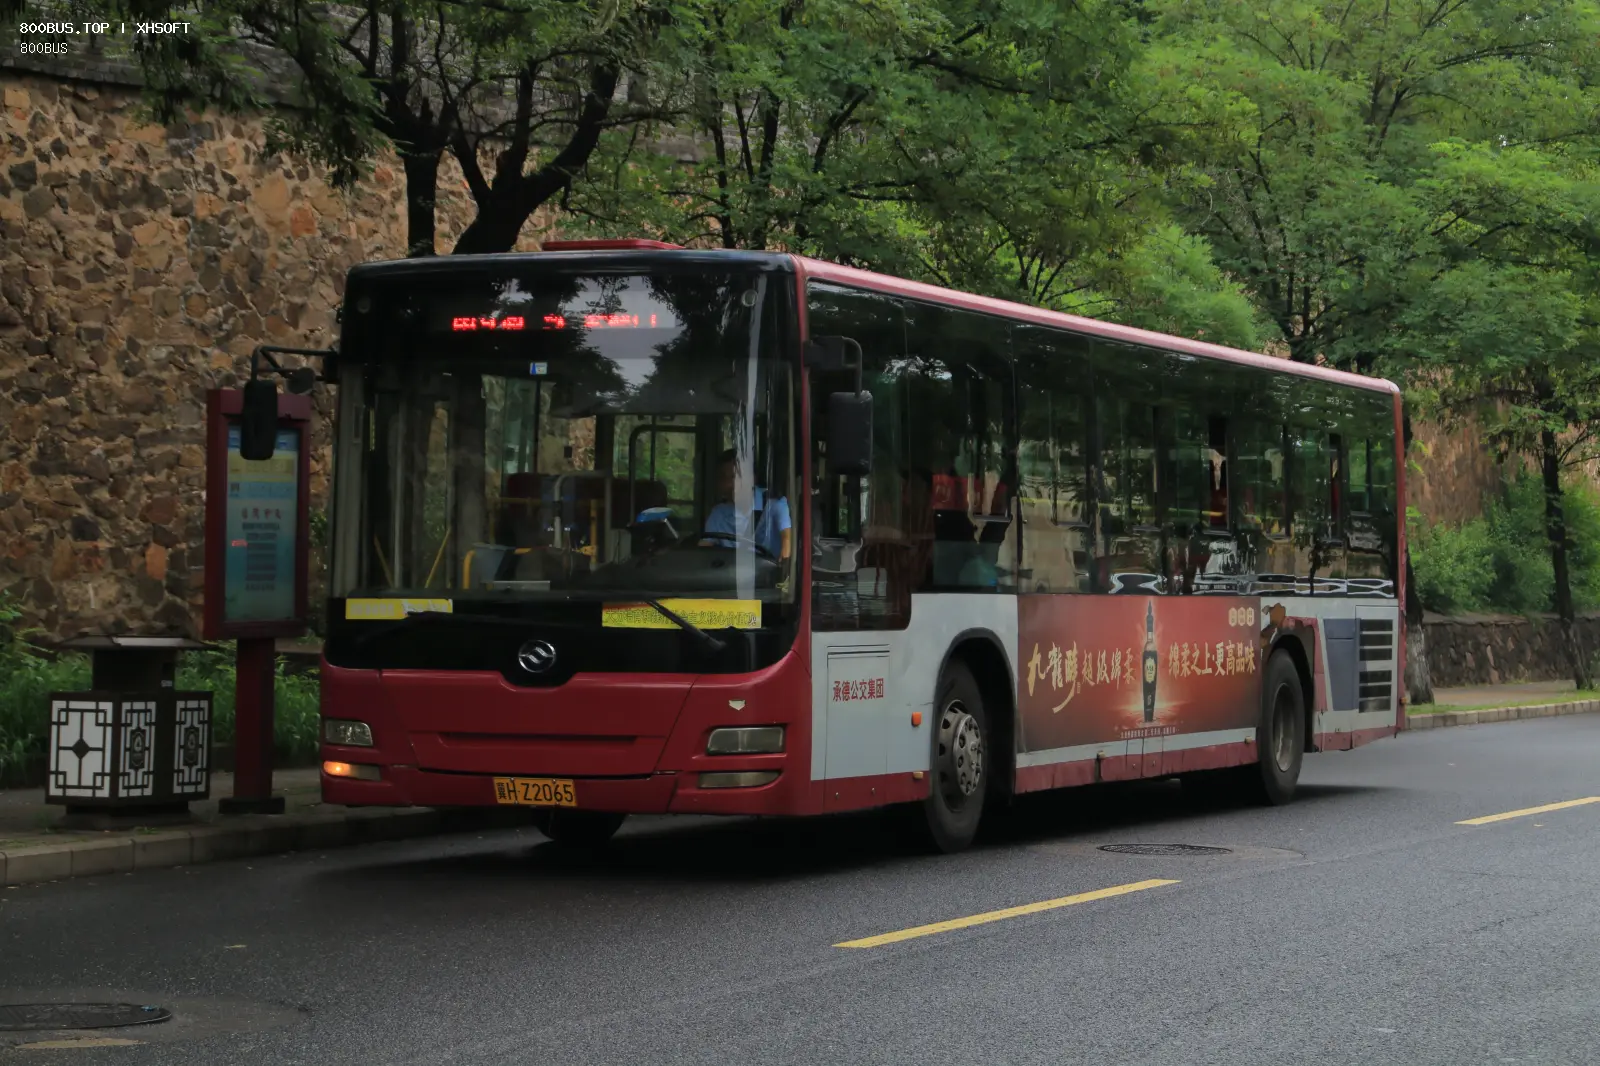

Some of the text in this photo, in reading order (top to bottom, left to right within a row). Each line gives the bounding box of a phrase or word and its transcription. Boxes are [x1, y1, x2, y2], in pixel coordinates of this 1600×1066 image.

[832, 677, 884, 702] 承德公交集团
